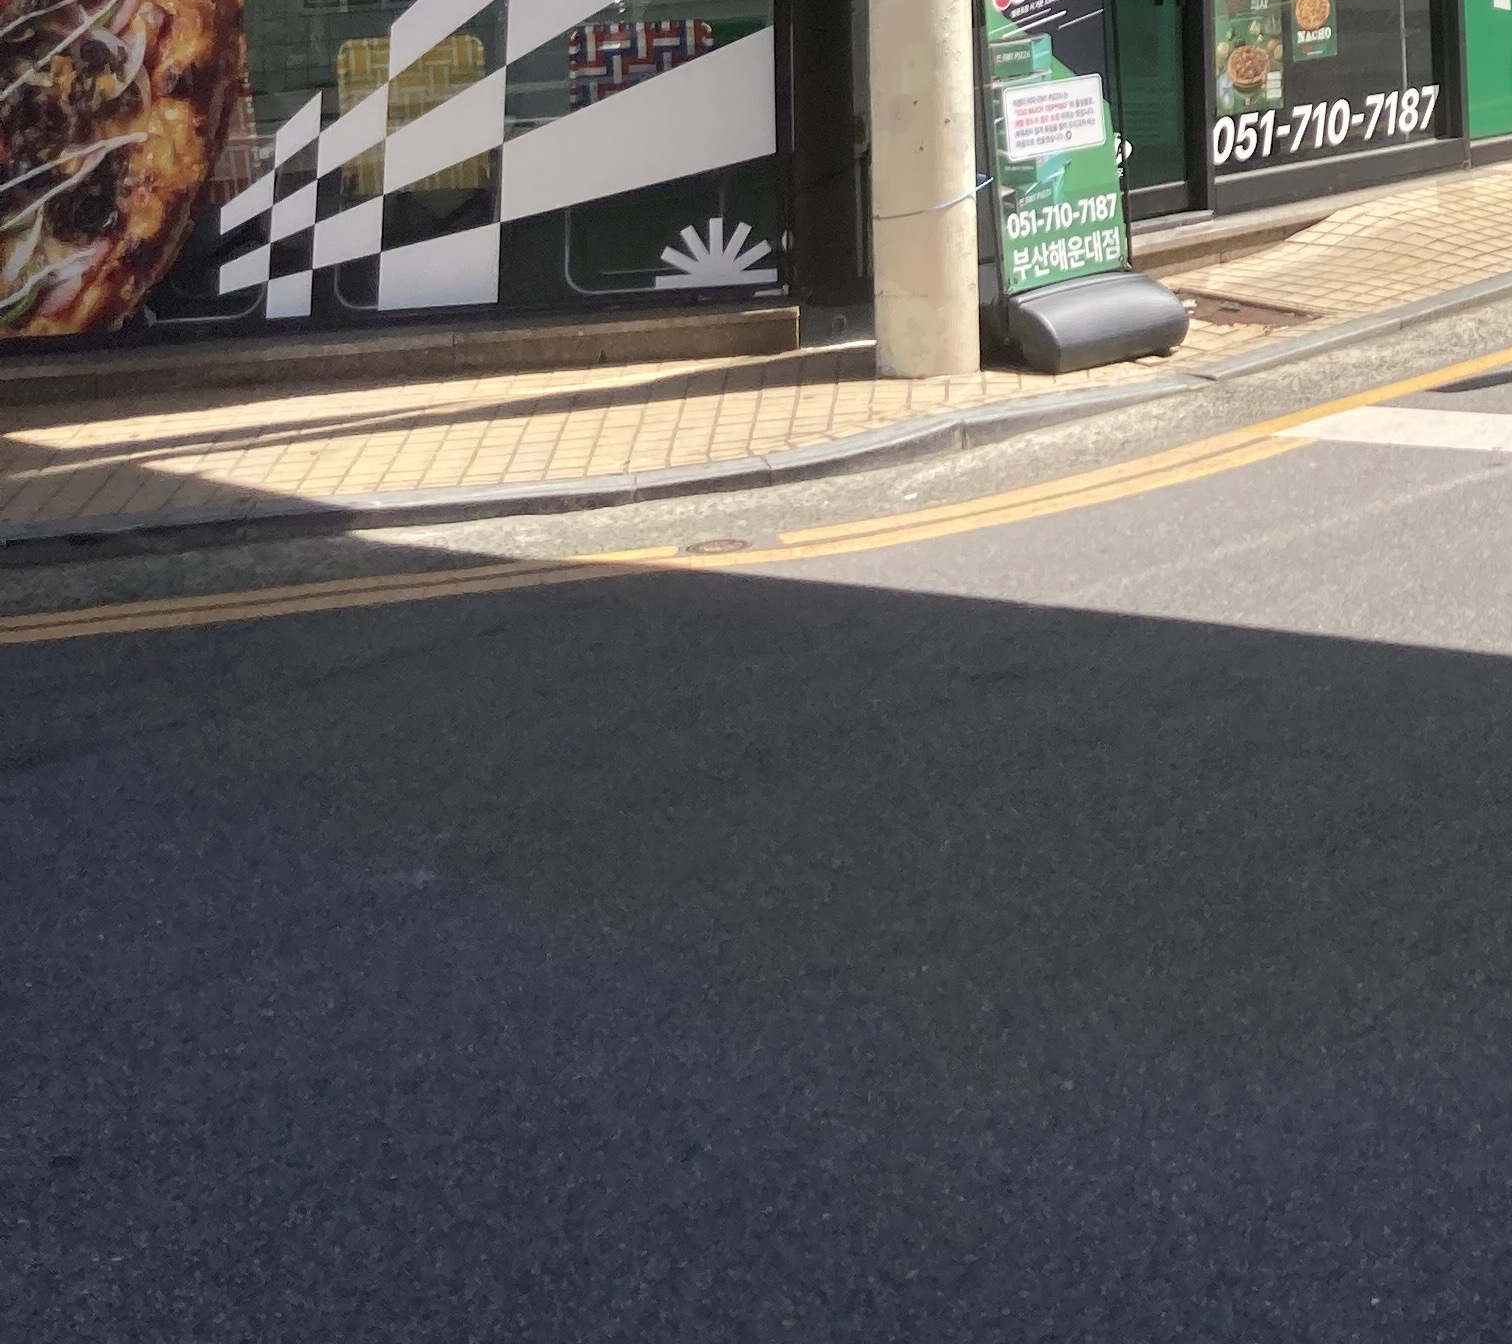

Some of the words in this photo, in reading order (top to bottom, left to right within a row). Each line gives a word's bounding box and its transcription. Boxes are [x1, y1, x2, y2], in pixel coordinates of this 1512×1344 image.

[1297, 27, 1332, 43] NACHO
[1212, 84, 1440, 166] 051-710-7187
[1007, 193, 1117, 239] 051-710-7187
[1012, 226, 1121, 281] 부산해운대점
